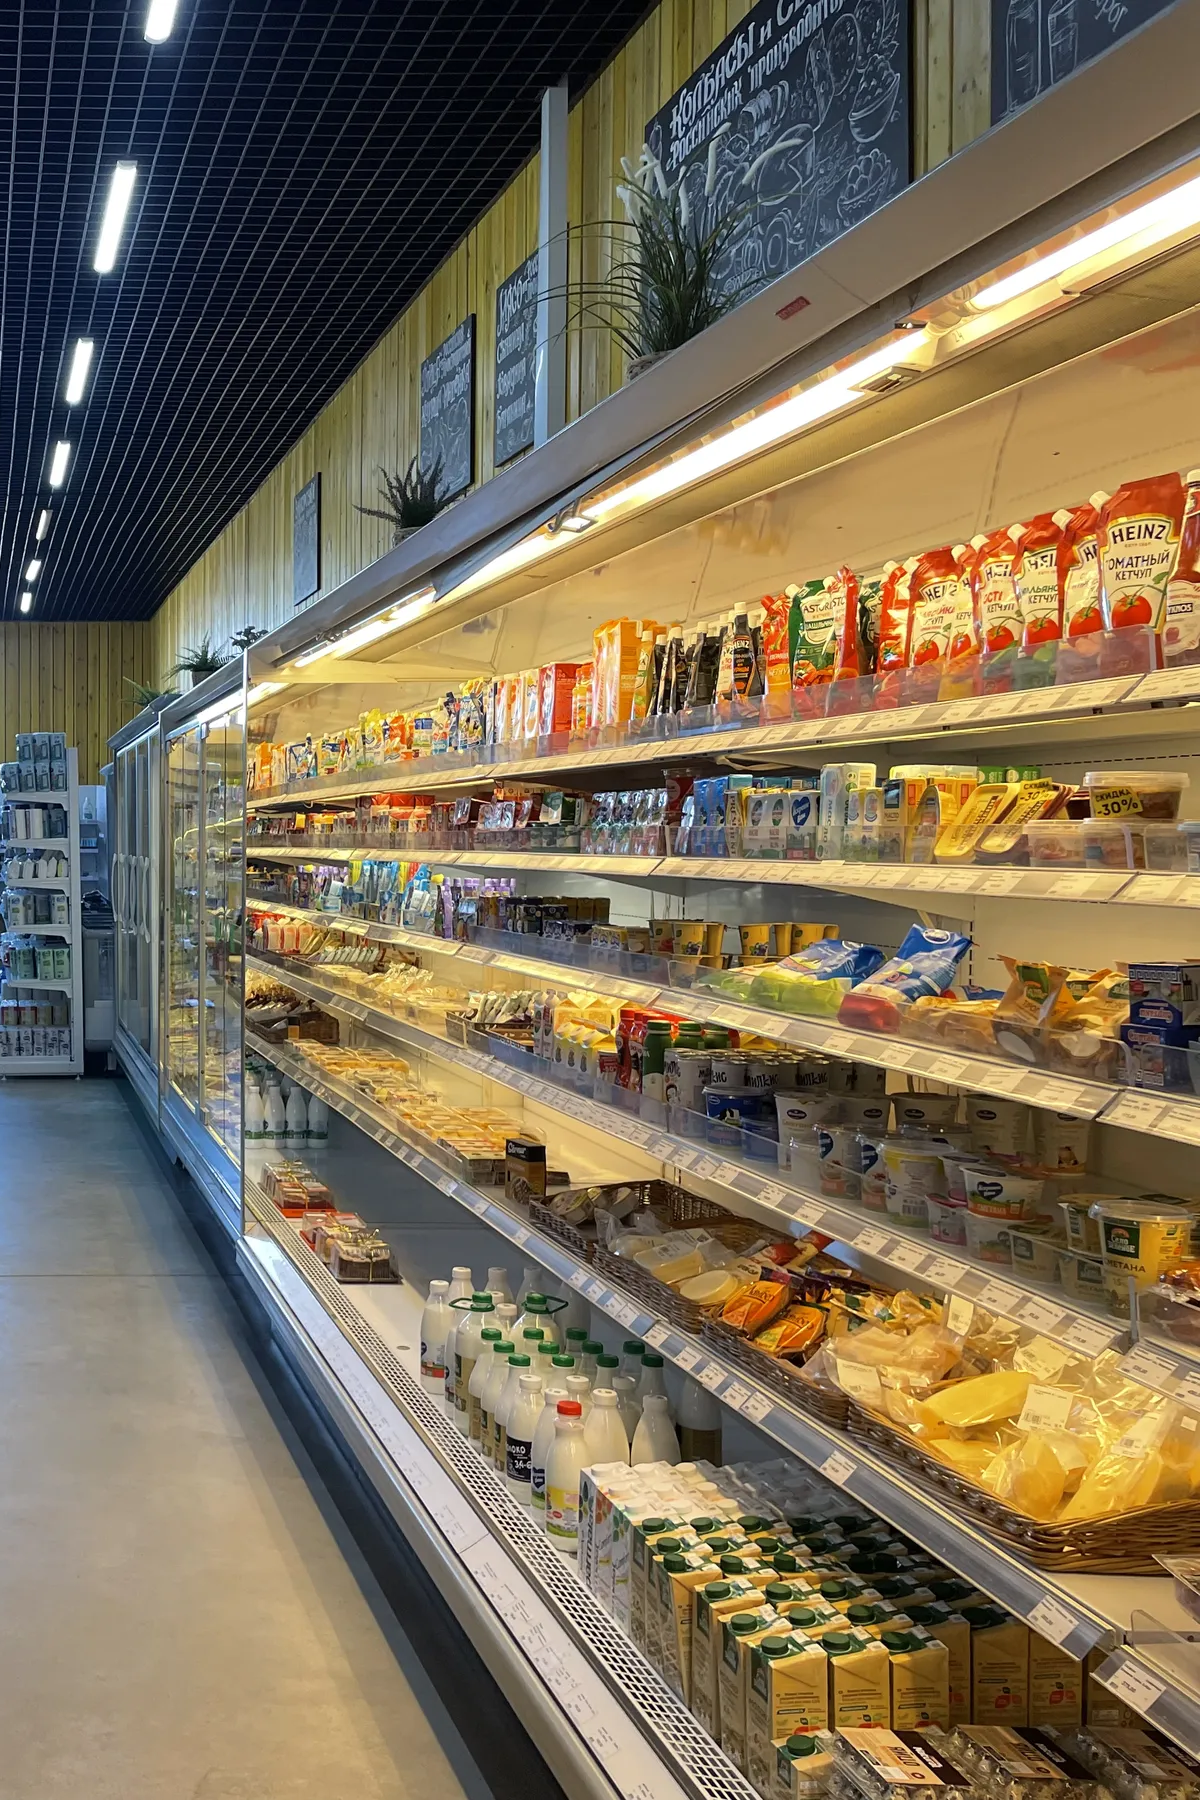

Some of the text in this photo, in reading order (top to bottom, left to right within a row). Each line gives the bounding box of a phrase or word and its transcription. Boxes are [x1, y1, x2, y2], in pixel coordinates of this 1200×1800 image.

[1112, 523, 1166, 544] HEINZ
[1115, 568, 1152, 581] КЕТЧУП
[1095, 788, 1132, 803] СКИДКА
[1097, 797, 1138, 816] -30%
